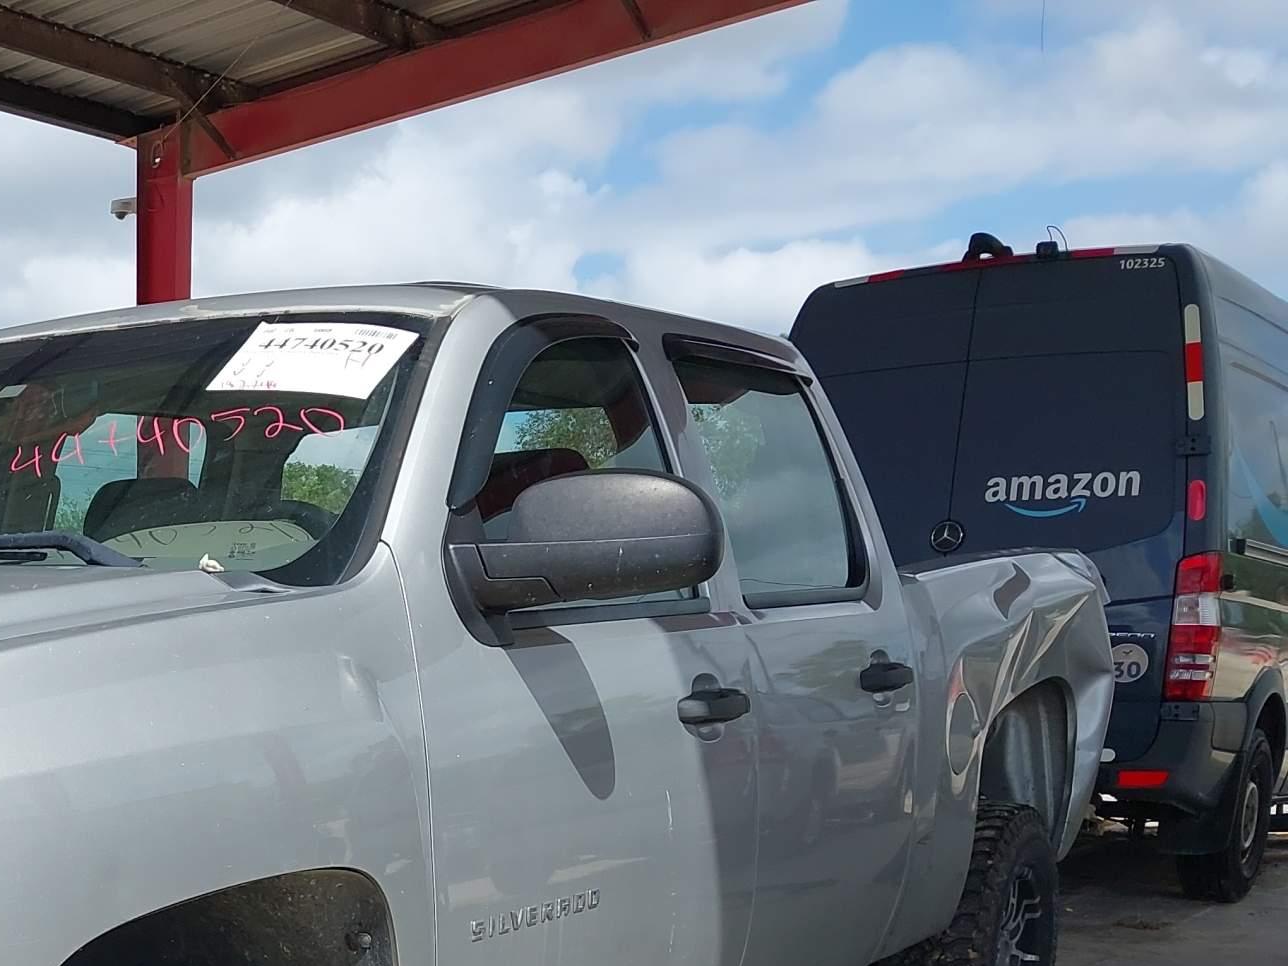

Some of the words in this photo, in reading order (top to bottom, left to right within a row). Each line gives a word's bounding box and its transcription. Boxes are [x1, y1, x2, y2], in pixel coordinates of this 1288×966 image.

[1119, 257, 1166, 270] 102325
[259, 337, 384, 355] 44740520
[985, 470, 1141, 503] amazon
[1113, 661, 1142, 679] 30
[470, 888, 601, 943] SILVERADO
